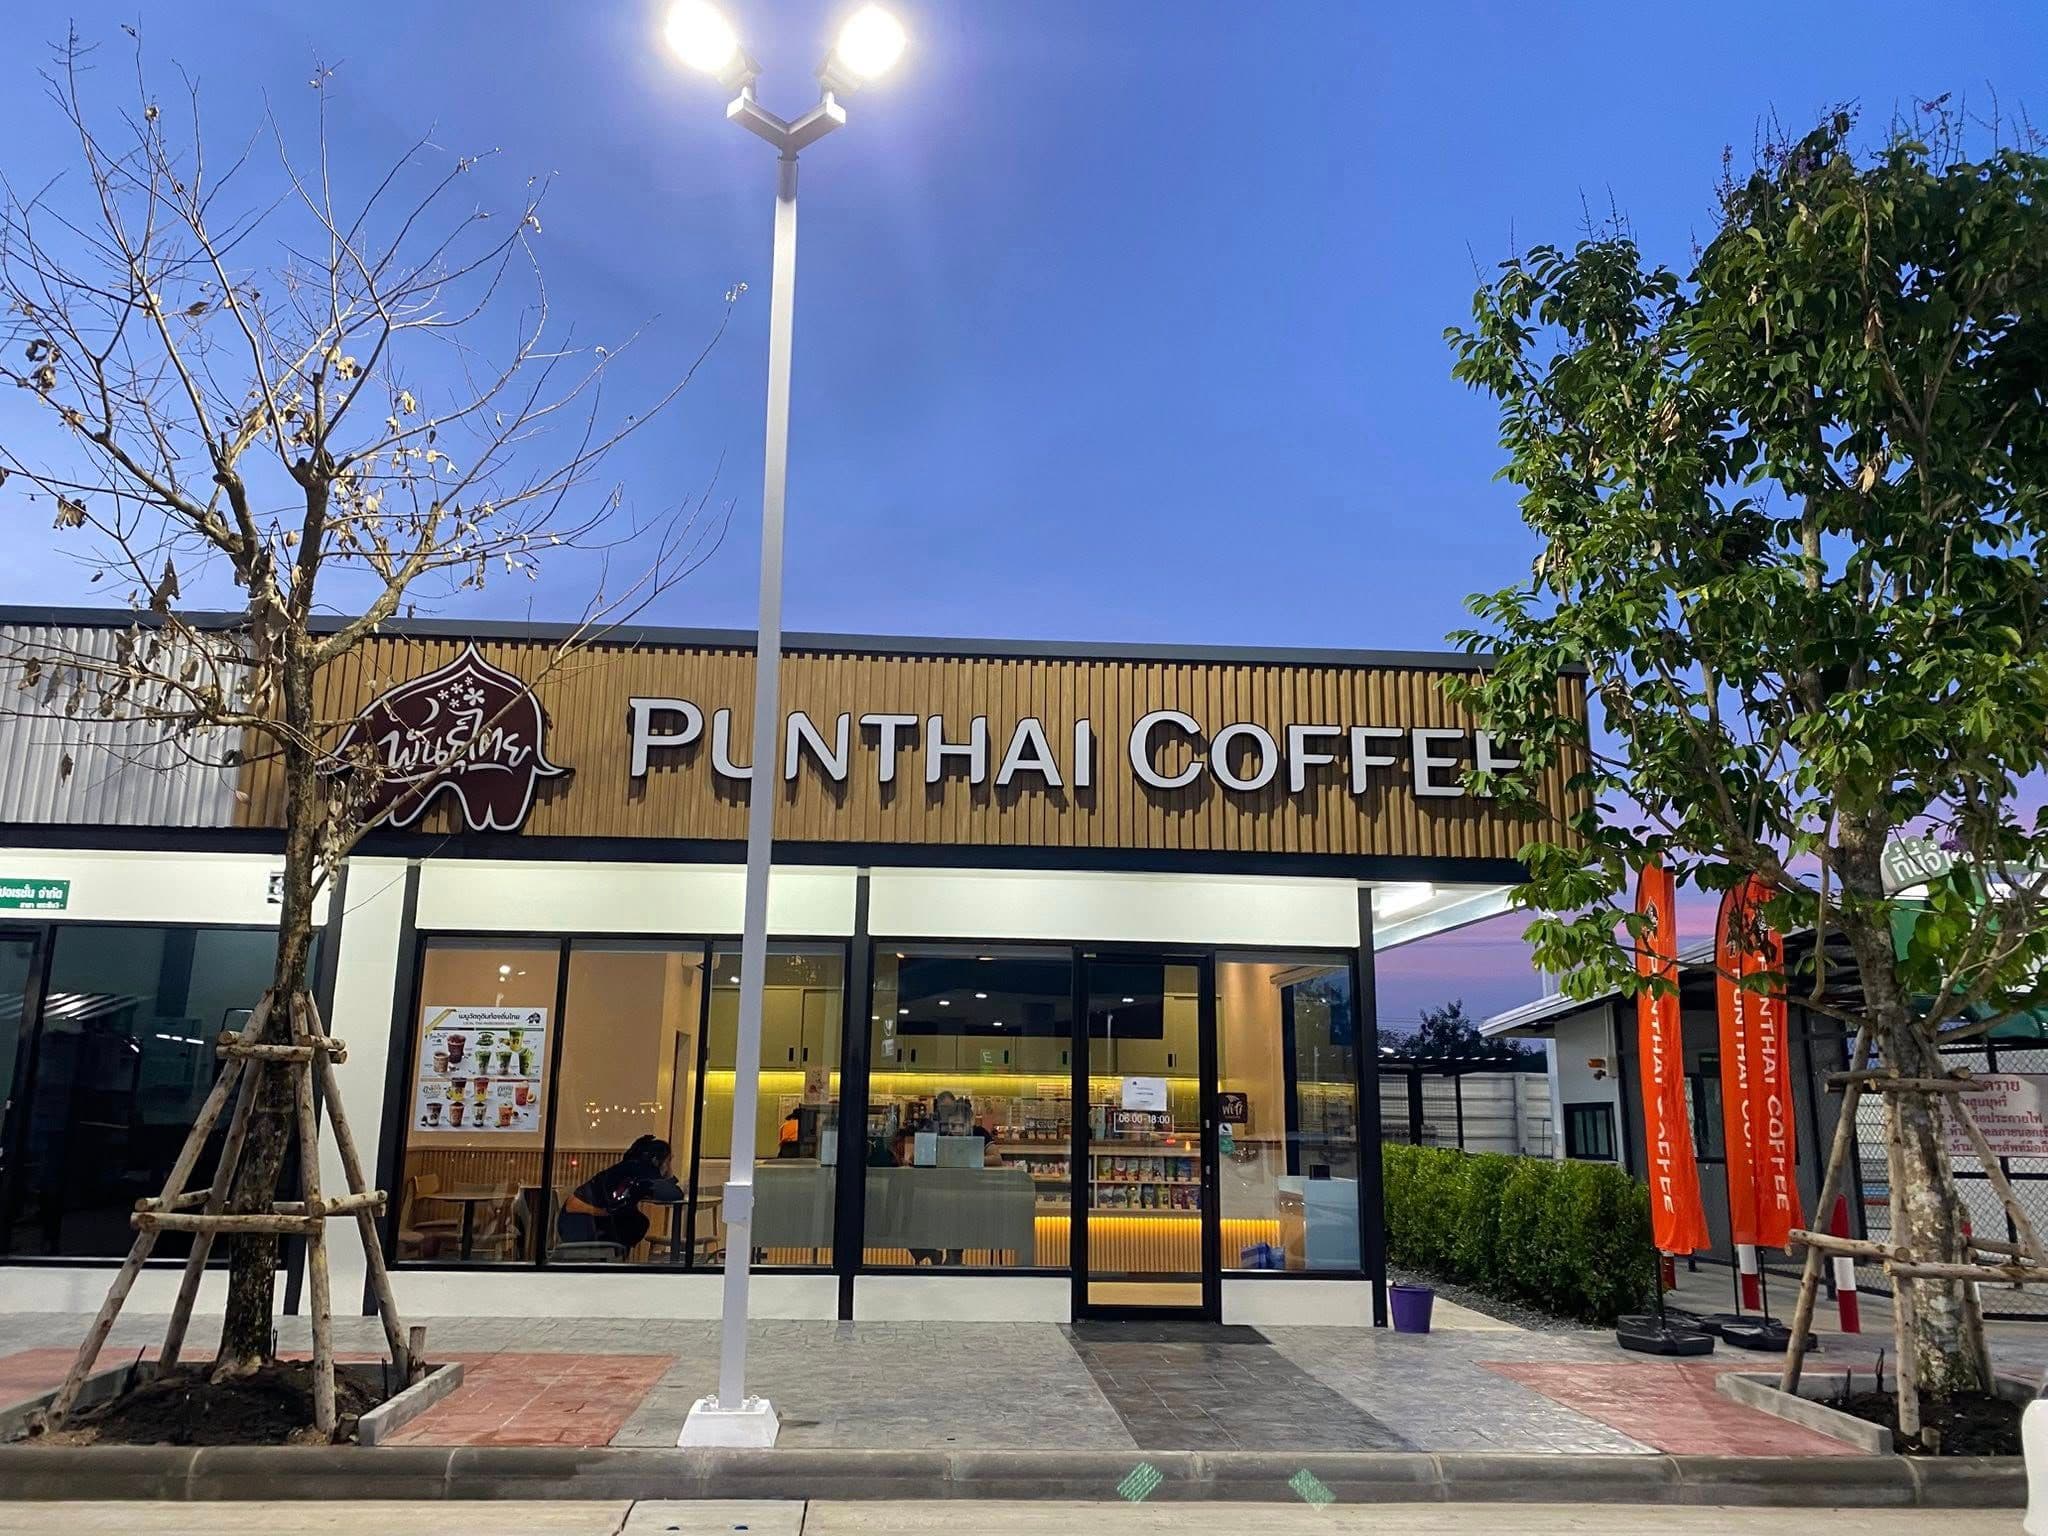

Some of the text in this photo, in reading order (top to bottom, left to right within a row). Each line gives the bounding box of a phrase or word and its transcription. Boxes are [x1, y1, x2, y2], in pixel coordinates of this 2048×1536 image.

[629, 697, 1530, 798] PUNTHAI COFFEE
[38, 886, 63, 899] จำกัด
[1648, 956, 1663, 1084] PNTHAI
[1757, 956, 1790, 1212] PNTHAI COFFEE
